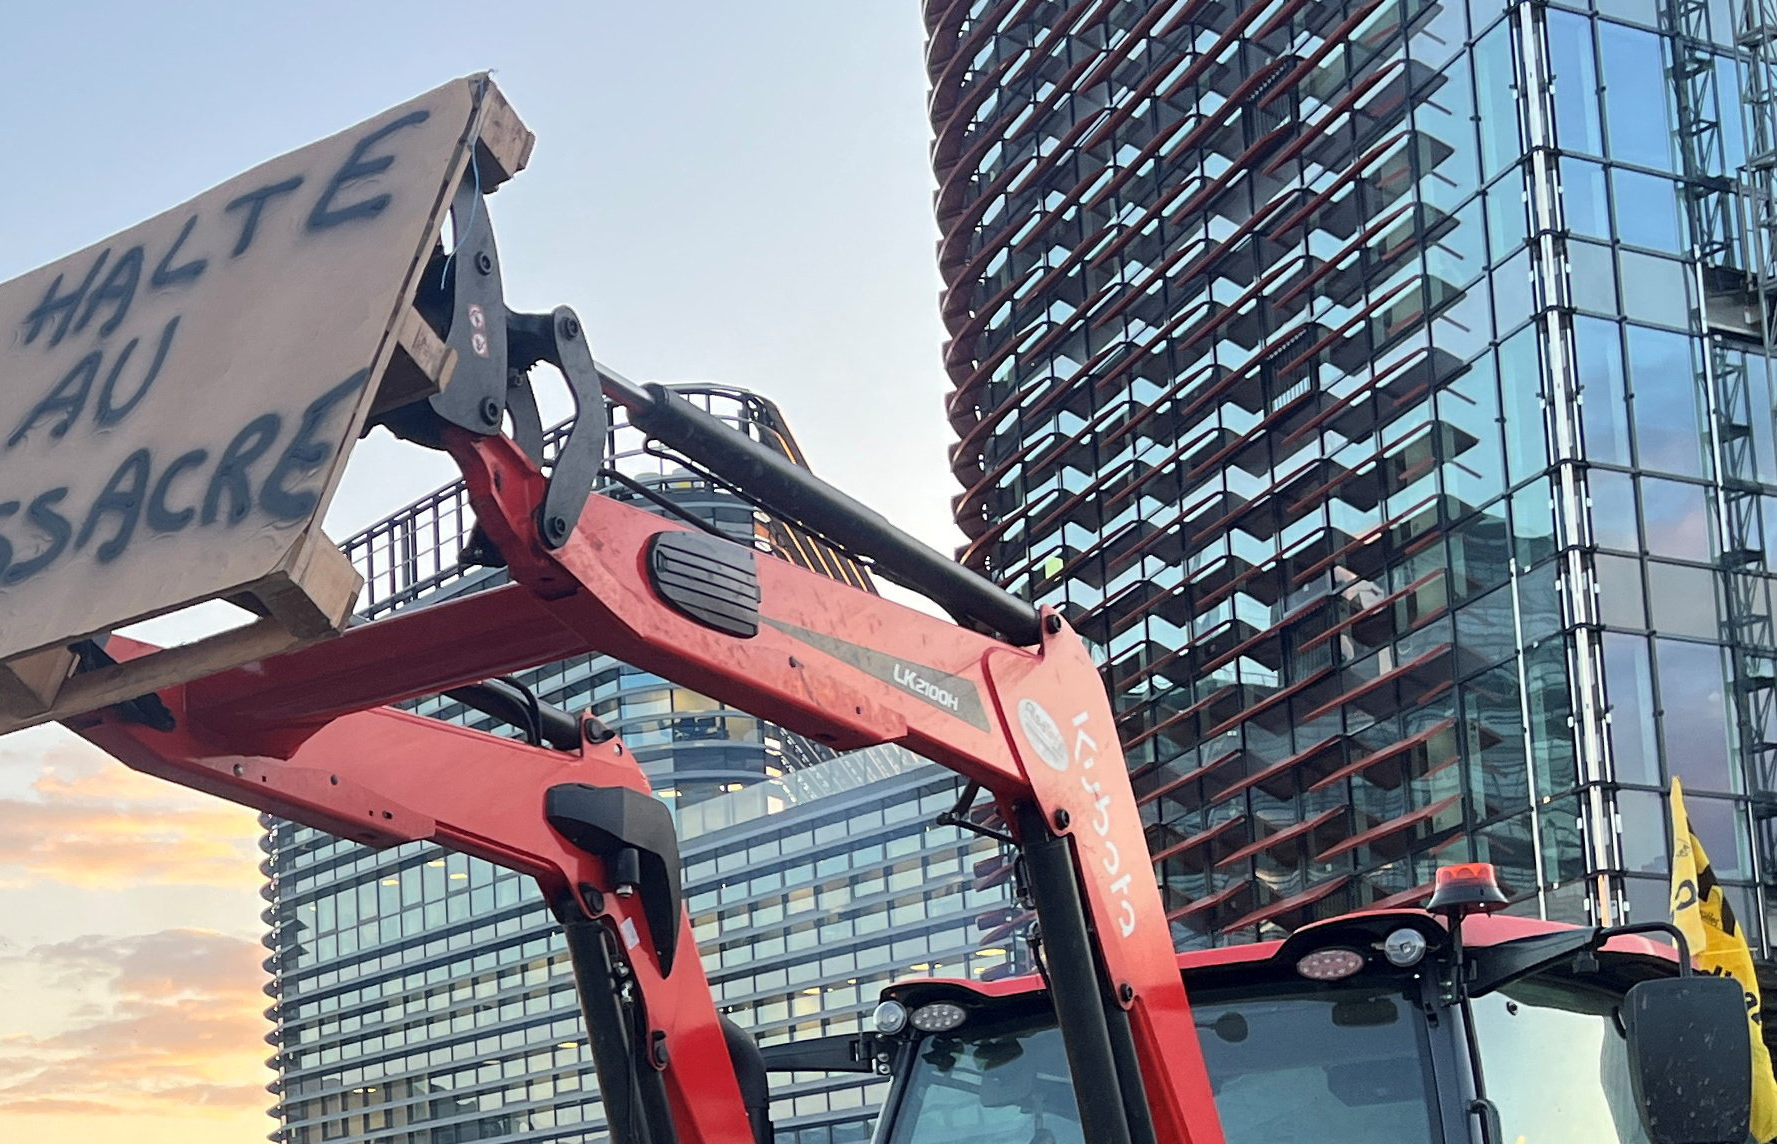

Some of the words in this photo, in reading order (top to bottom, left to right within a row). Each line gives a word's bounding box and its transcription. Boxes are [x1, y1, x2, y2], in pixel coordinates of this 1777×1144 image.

[23, 109, 431, 347] HALTE
[9, 315, 181, 447] AU
[893, 663, 959, 711] LK2100H
[1071, 710, 1136, 938] Kubota
